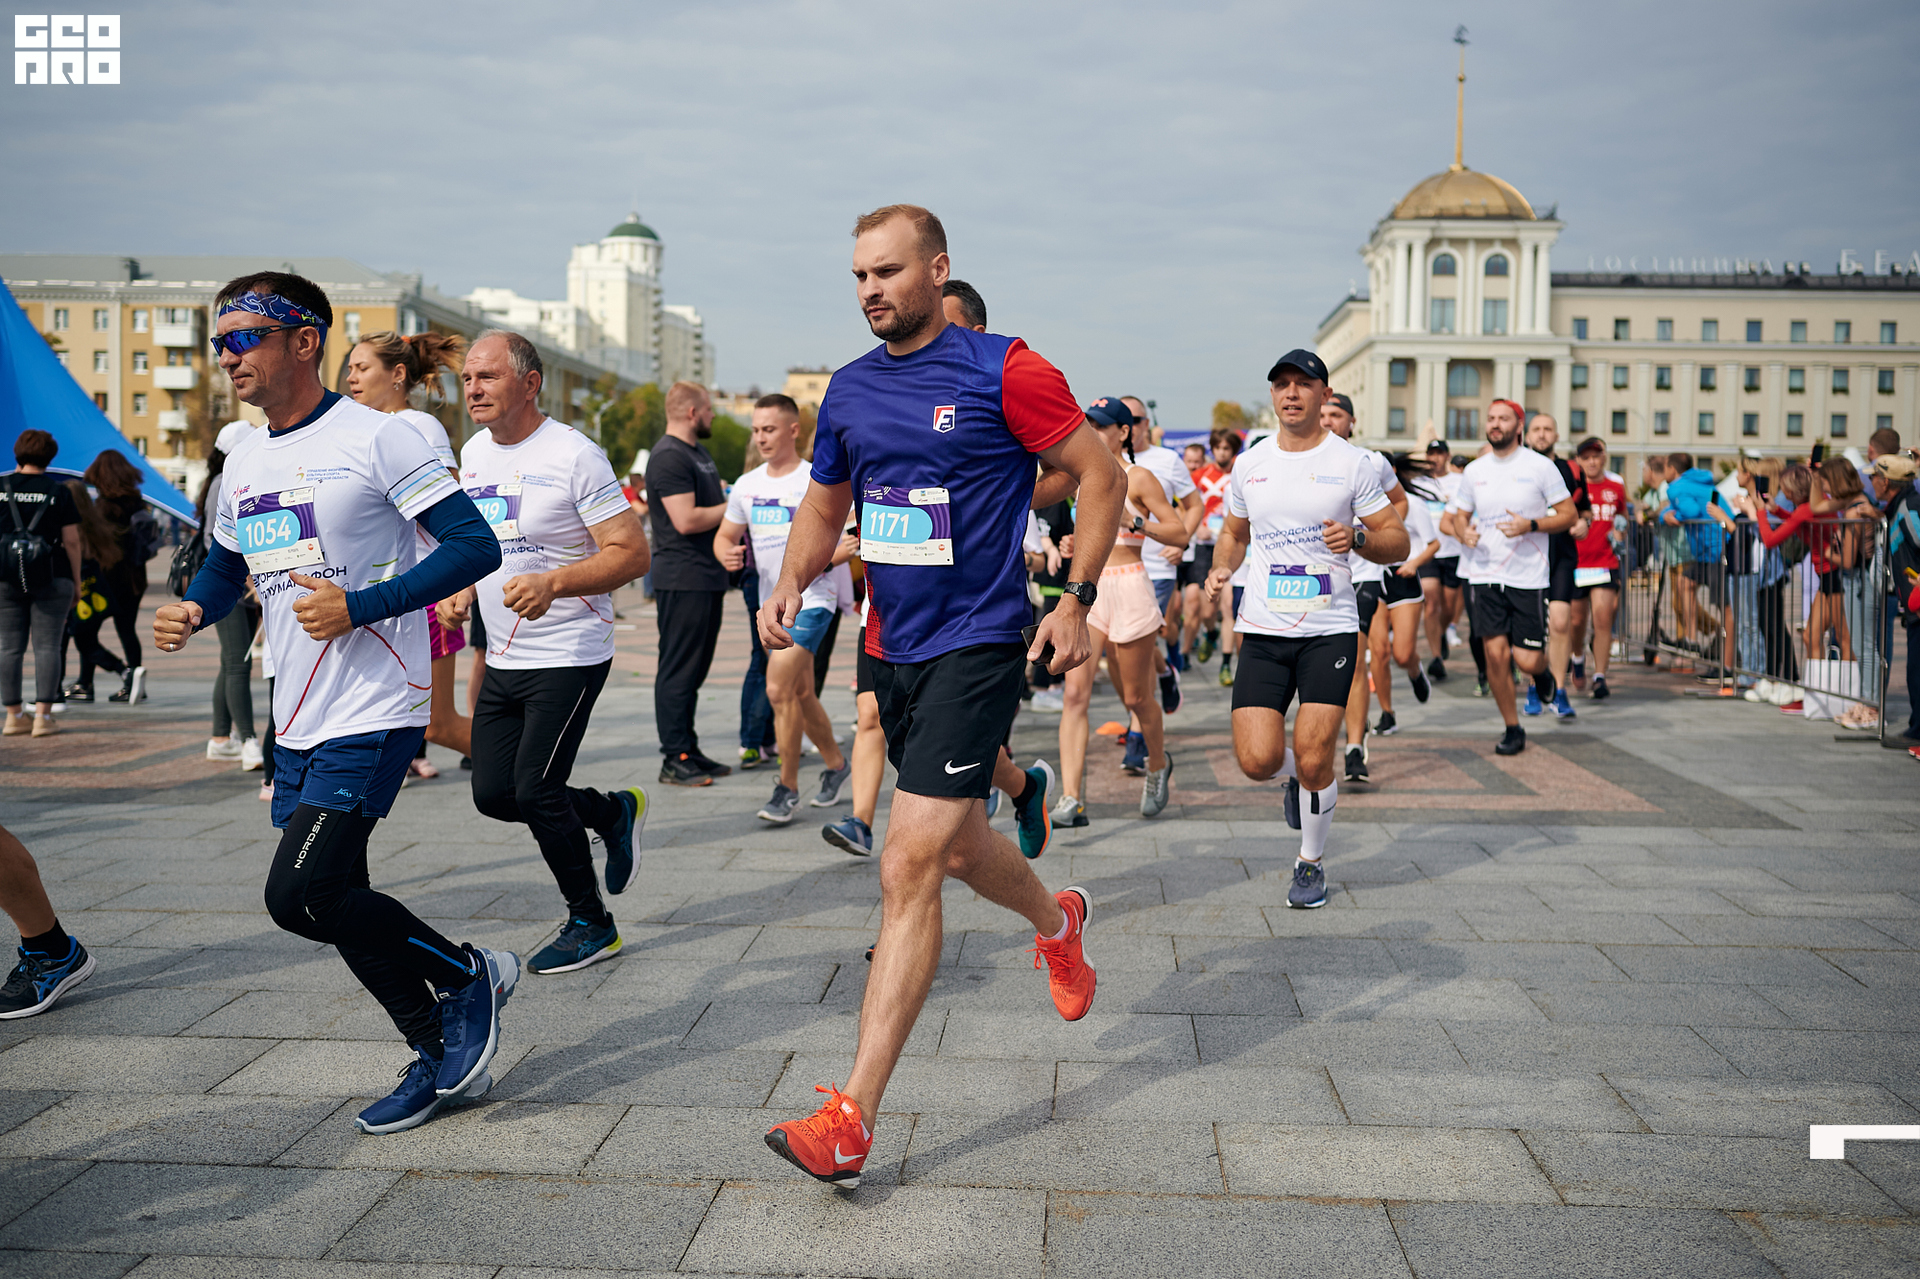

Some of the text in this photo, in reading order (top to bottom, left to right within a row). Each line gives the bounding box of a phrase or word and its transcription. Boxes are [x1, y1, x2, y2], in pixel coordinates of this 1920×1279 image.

[756, 509, 782, 523] 1193
[870, 511, 909, 538] 1171
[245, 516, 291, 548] 1054
[503, 545, 544, 556] РАФОН
[504, 556, 548, 575] 2021
[1275, 579, 1310, 597] 1021
[293, 812, 328, 869] NORDSKI
